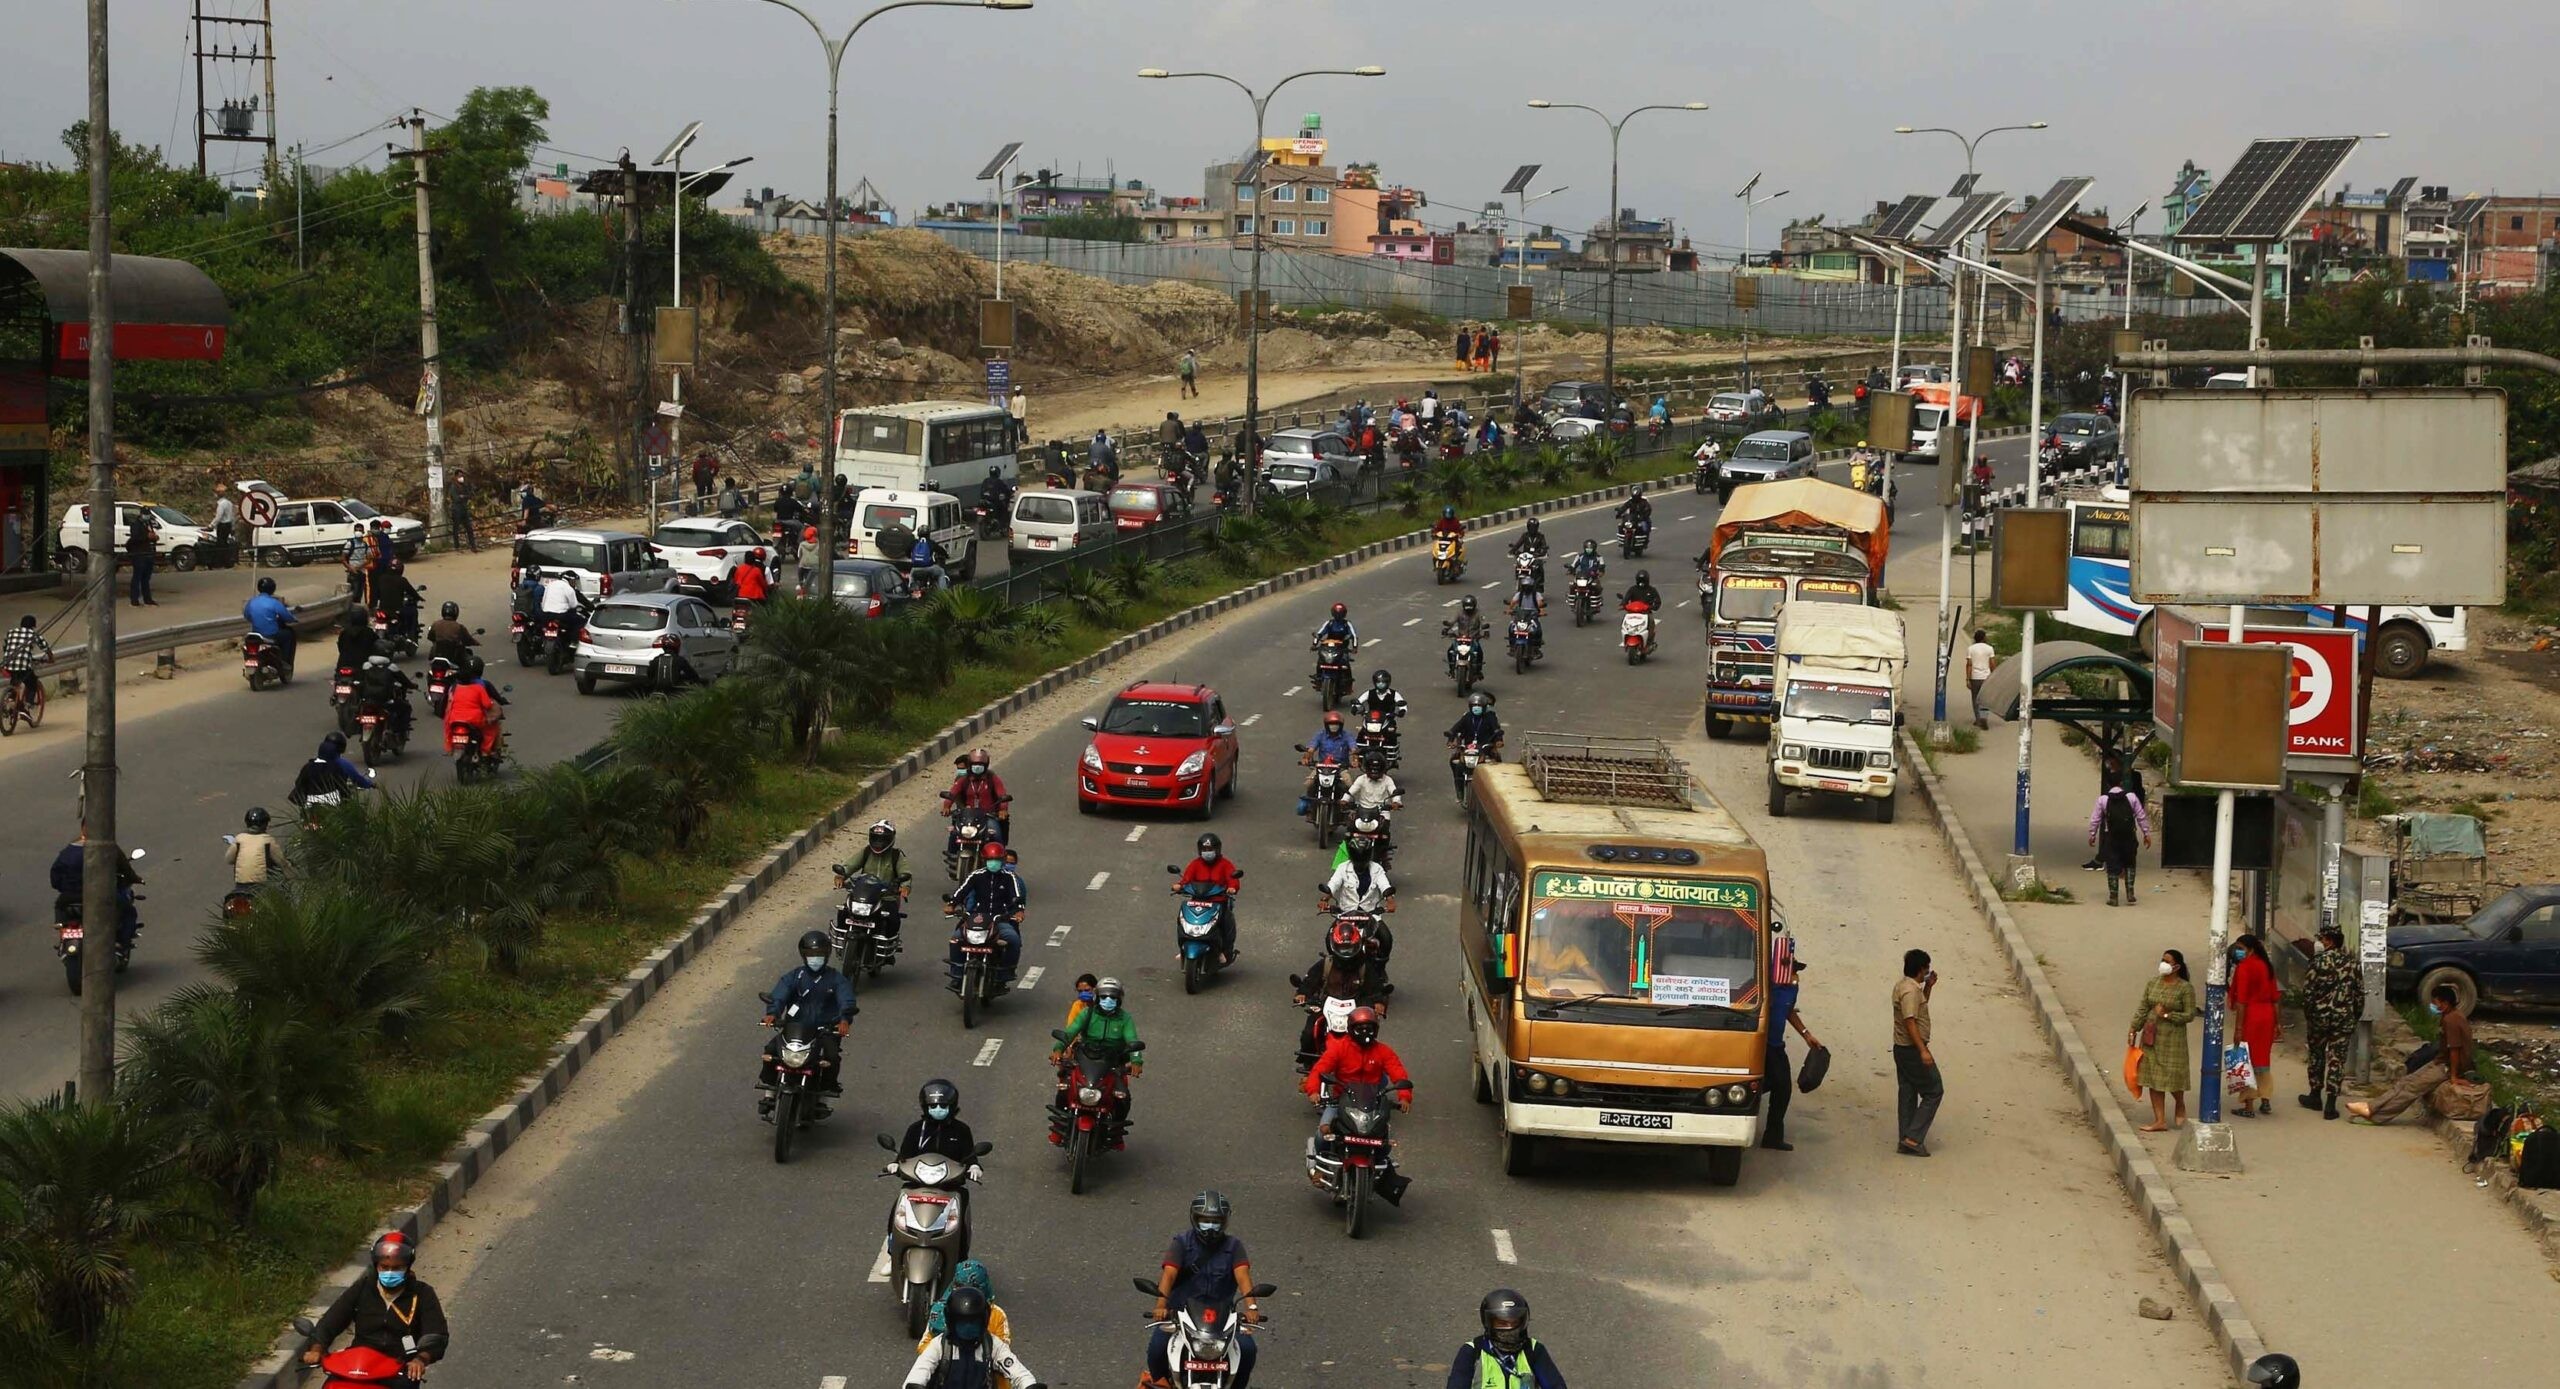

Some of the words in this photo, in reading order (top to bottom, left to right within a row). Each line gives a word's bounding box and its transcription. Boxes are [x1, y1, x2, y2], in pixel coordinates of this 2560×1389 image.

[249, 498, 270, 520] P
[2086, 509, 2112, 520] New
[2293, 736, 2345, 747] BANK
[1577, 876, 1637, 897] नेपाल
[1654, 884, 1720, 902] यातायात
[1632, 1115, 1672, 1129] ८४९१
